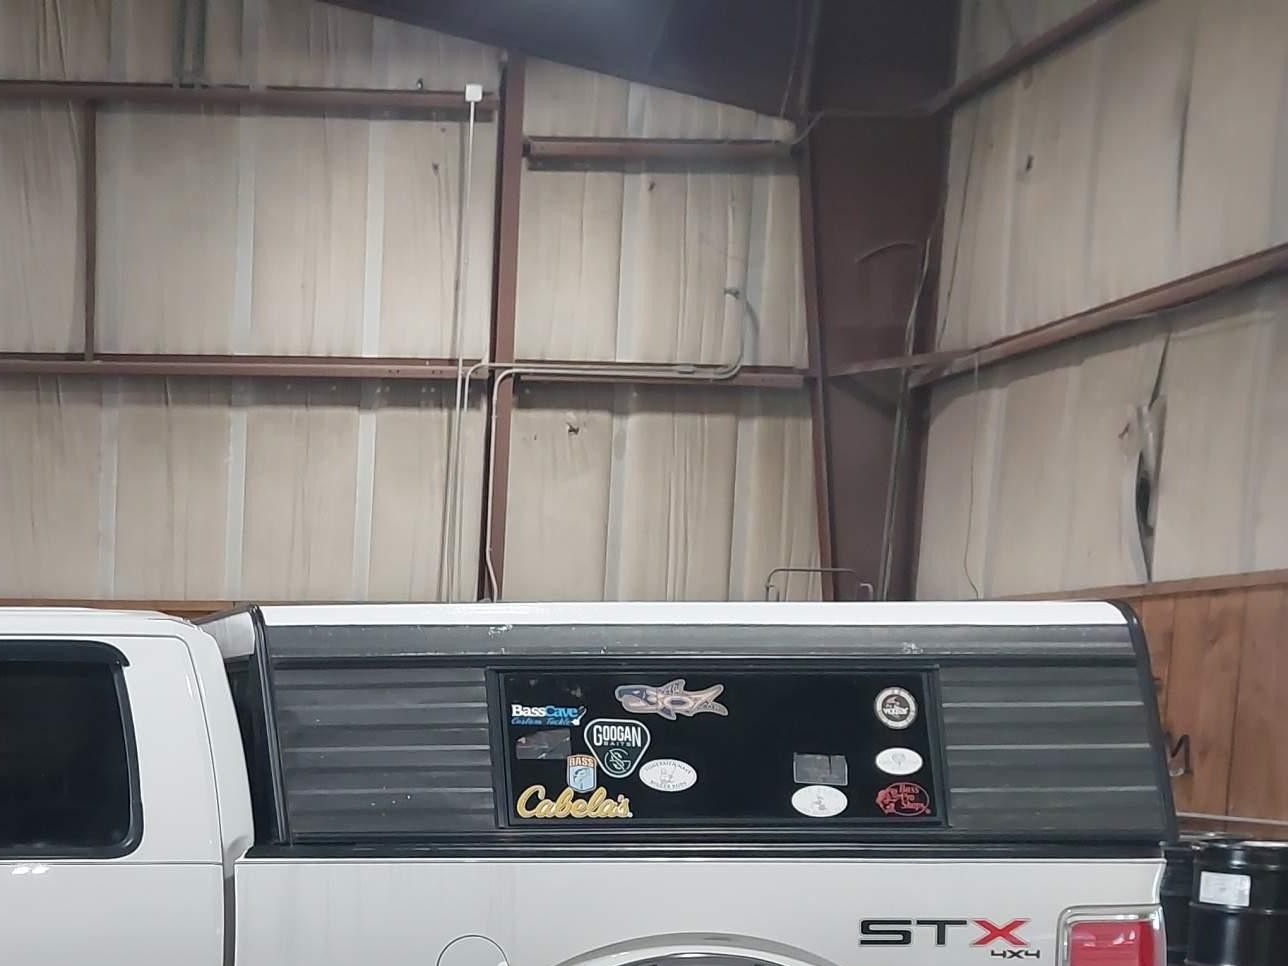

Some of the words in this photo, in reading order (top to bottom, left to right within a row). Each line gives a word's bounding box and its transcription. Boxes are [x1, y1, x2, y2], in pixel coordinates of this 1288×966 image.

[593, 725, 642, 747] GOOGAN
[516, 784, 631, 818] Cabela's
[858, 918, 1031, 947] STX
